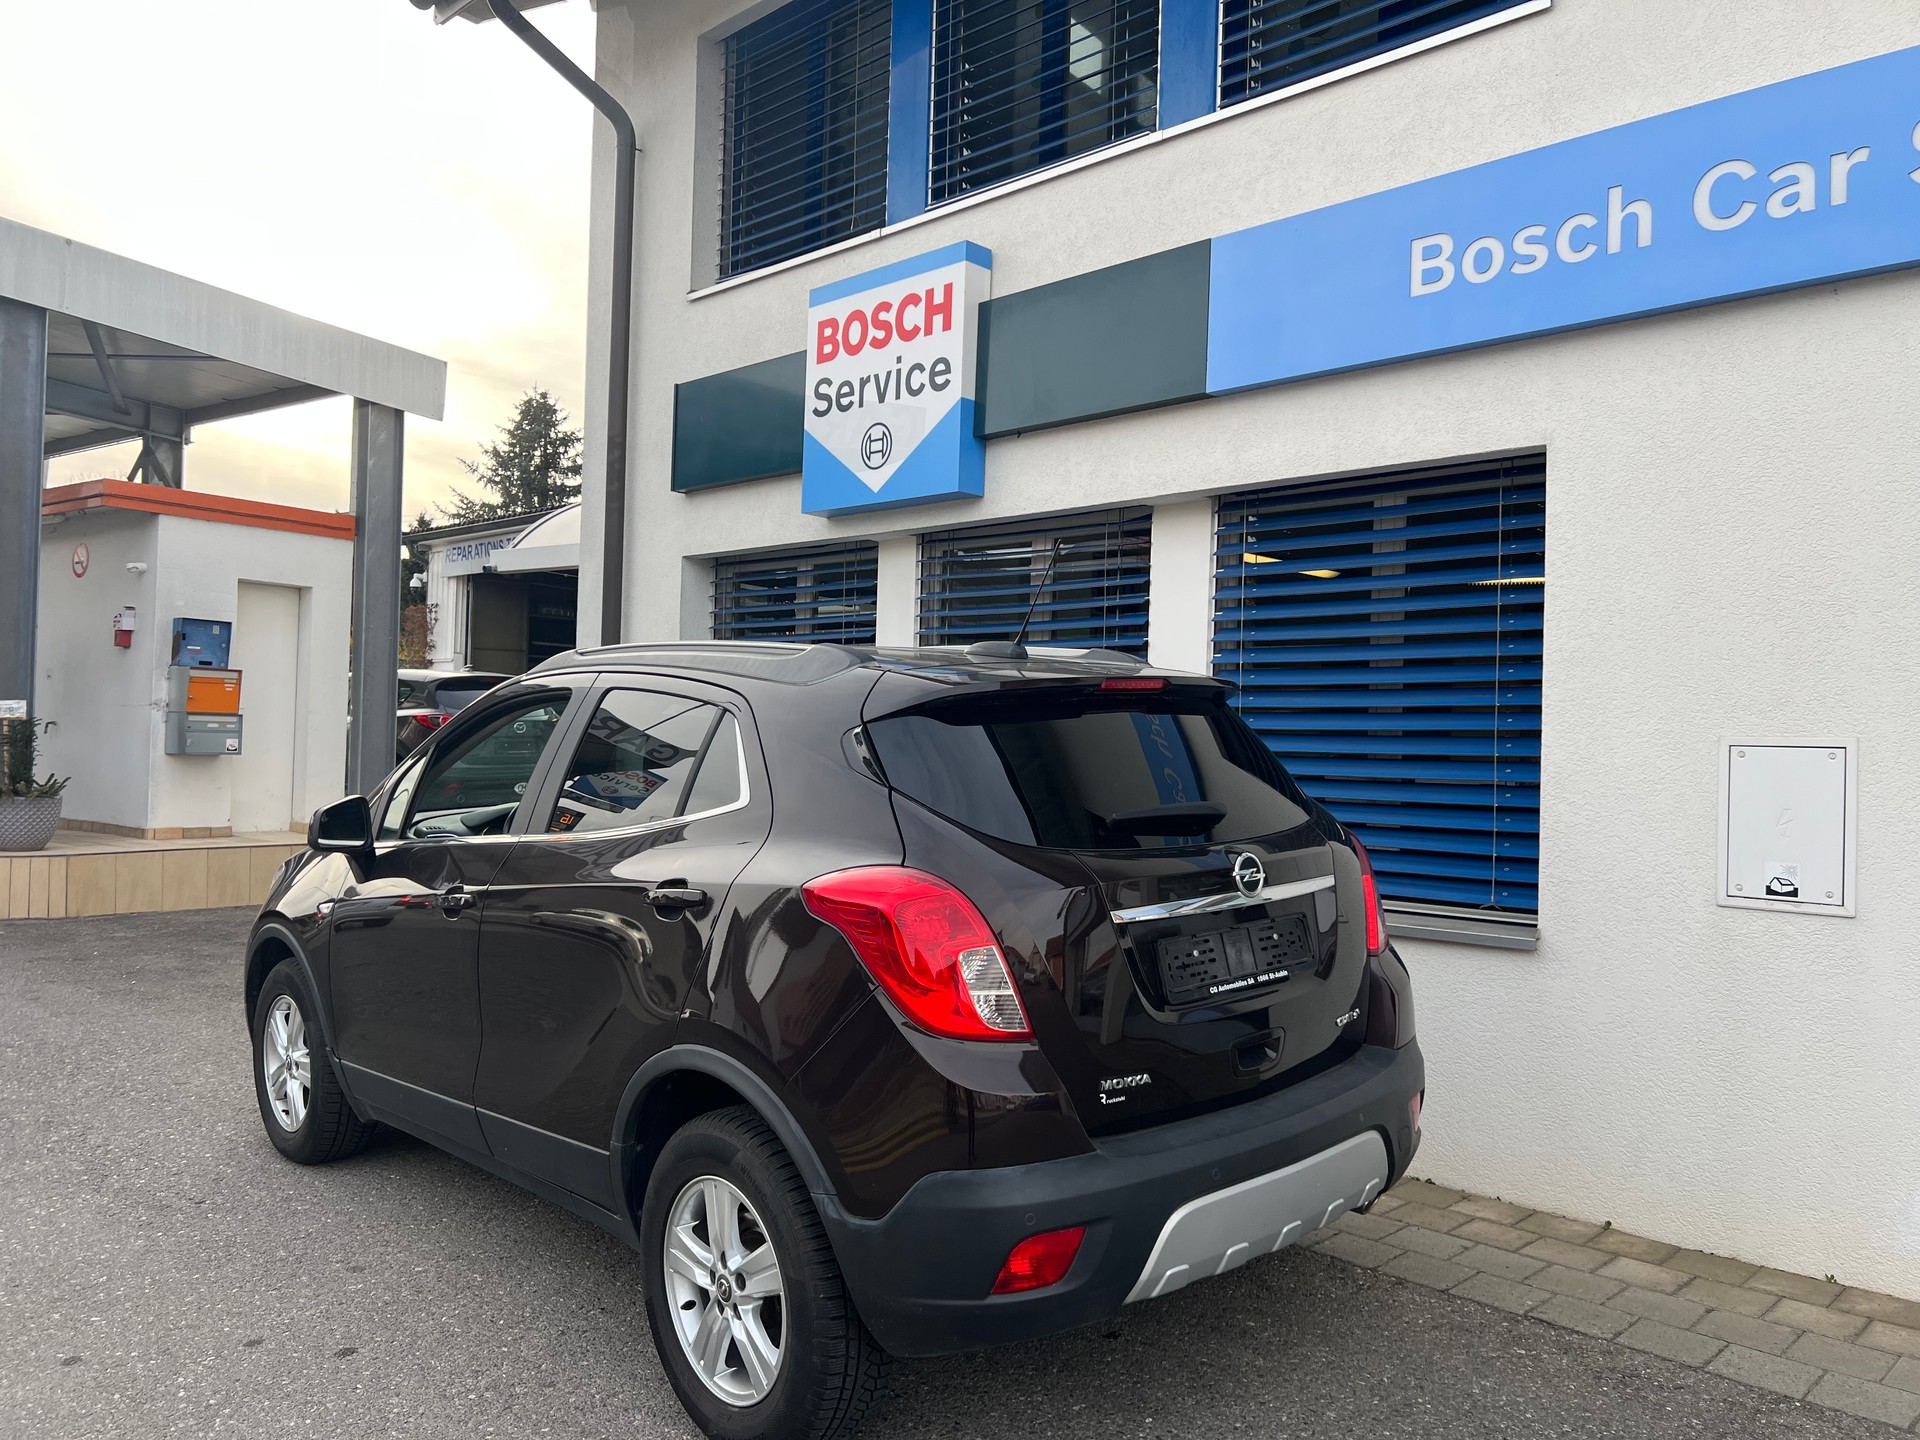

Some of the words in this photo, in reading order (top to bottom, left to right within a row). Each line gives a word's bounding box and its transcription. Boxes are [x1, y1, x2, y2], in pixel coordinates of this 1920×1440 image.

[1409, 184, 1652, 297] Bosch
[1692, 145, 1871, 232] Car
[816, 282, 953, 365] BOSCH
[812, 355, 951, 418] Service
[1100, 1073, 1152, 1091] MOKKA
